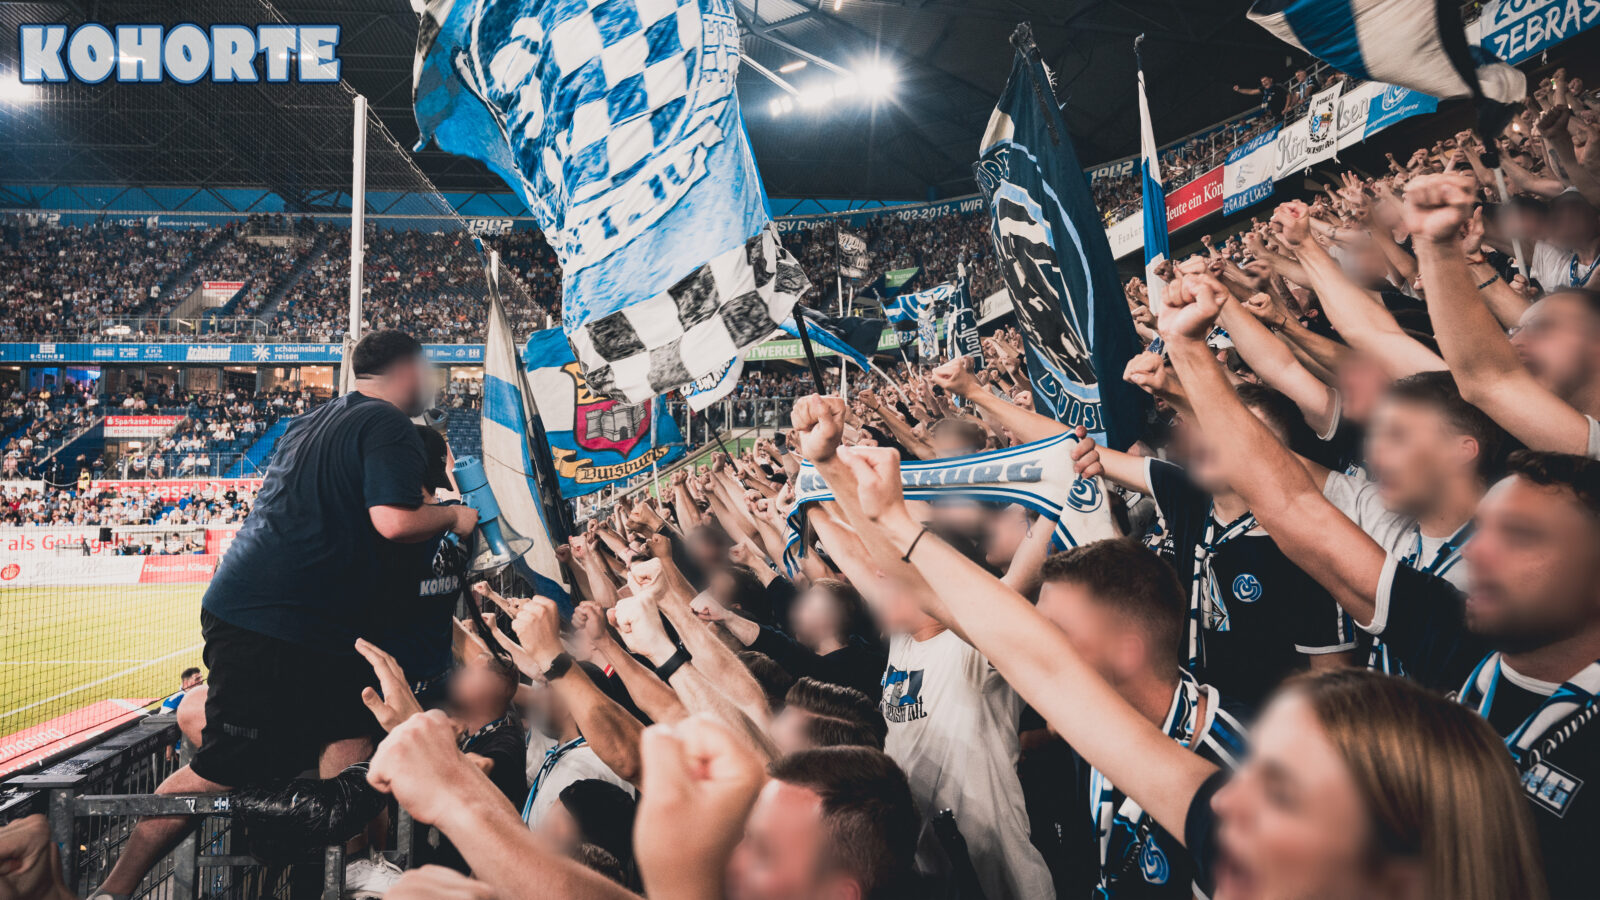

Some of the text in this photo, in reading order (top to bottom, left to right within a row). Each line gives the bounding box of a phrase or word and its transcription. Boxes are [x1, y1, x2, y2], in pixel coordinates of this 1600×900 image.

[1493, 0, 1600, 60] ZEBRAS
[1276, 130, 1308, 172] Kön
[1188, 192, 1202, 210] ein
[1203, 180, 1223, 204] Kön
[896, 203, 950, 221] 902-2013
[960, 199, 983, 212] WIR
[468, 219, 514, 234] 1902
[274, 345, 326, 353] schauinsland
[114, 417, 149, 426] Sparkasse
[799, 474, 833, 493] MS
[8, 534, 36, 551] als
[418, 575, 460, 597] KOHOR
